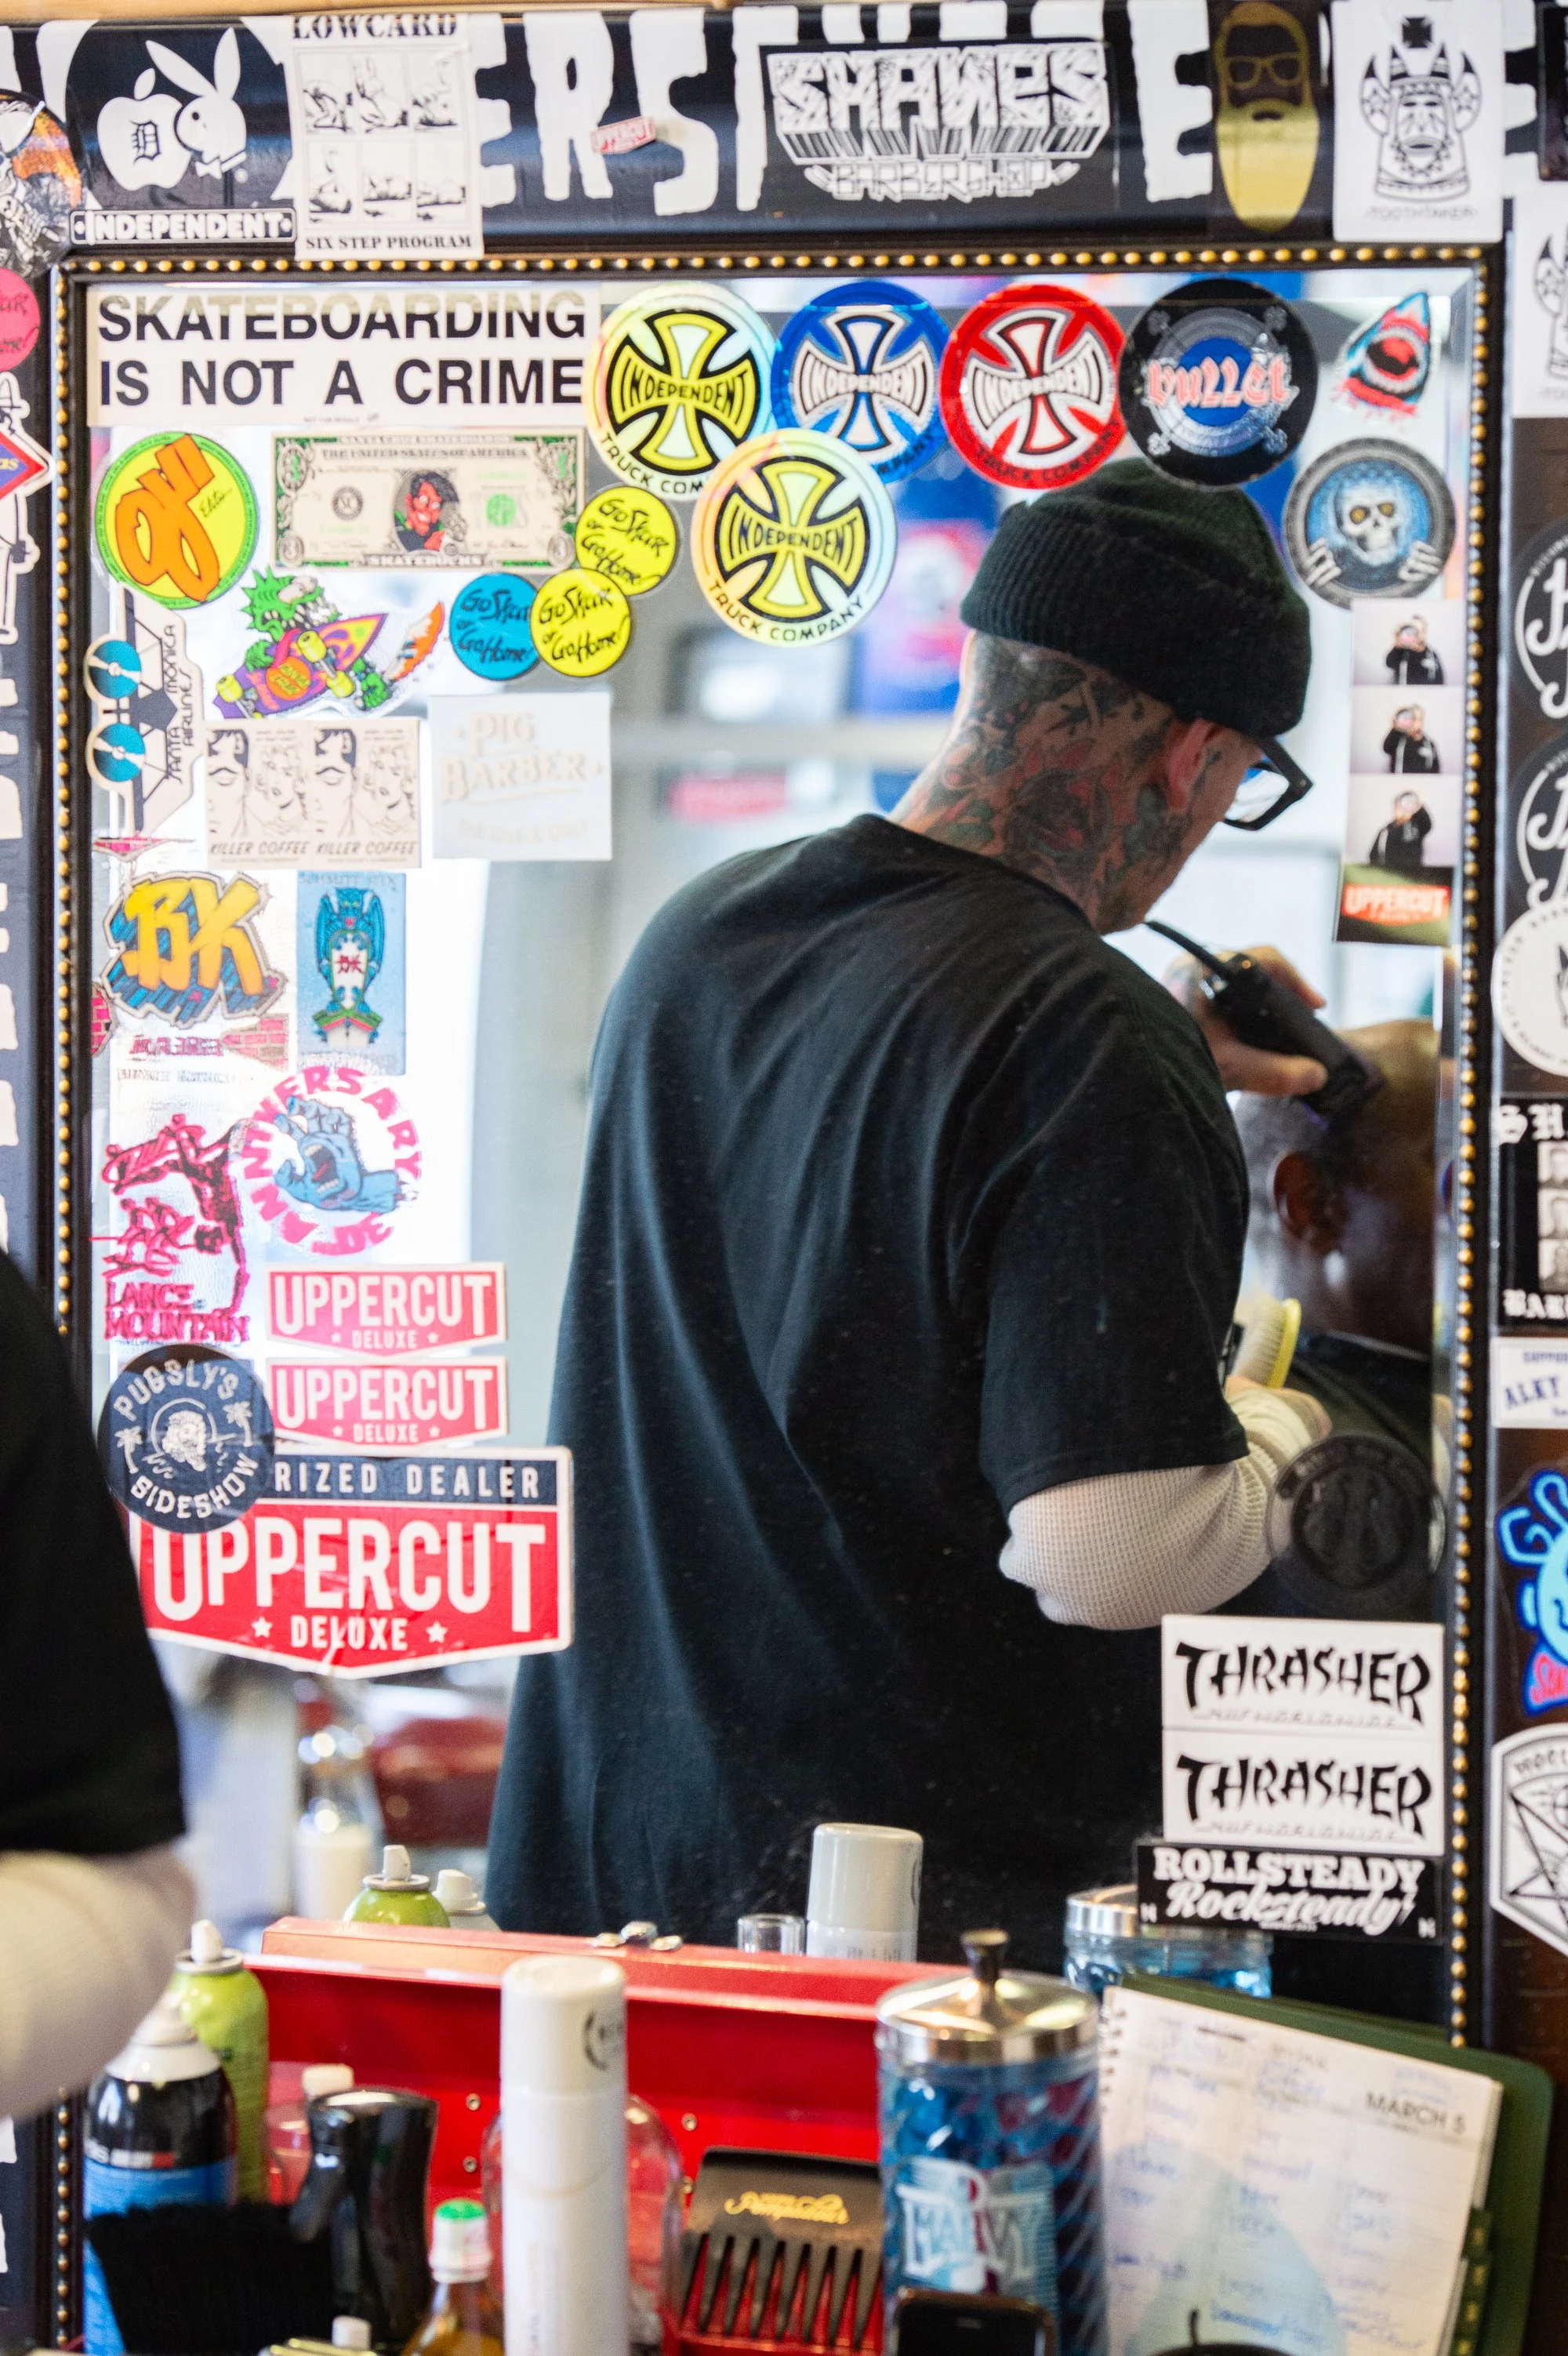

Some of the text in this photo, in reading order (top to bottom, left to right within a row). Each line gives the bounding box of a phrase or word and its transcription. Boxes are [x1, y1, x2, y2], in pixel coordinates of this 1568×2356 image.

[292, 13, 457, 39] LOWCARD
[86, 212, 282, 241] INDEPENDENT
[307, 235, 472, 251] SIX STEP PROGRAM
[99, 289, 586, 340] SKATEBOARDING
[100, 358, 583, 405] IS NOT A CRIME
[629, 361, 750, 427] INDEPENDENT
[815, 361, 928, 412] INDEPENDENT
[985, 350, 1096, 416] INDEPENDENT
[322, 448, 349, 459] THE
[470, 448, 528, 458] AMERICA
[600, 432, 652, 487] TRUCK
[735, 505, 858, 574] INDEPENDENT
[710, 579, 866, 642] TRUCK COMPANY
[163, 625, 177, 694] MONICA
[180, 669, 193, 746] AIRLINES
[470, 712, 535, 757] PIG
[441, 750, 586, 804] BARBER
[209, 840, 310, 855] KILLER COFFEE
[316, 840, 418, 855] KILLER COFFEE
[103, 1312, 251, 1343] MOUNTAIN
[274, 1274, 493, 1336] UPPERCUT
[351, 1330, 418, 1349] DELUXE
[114, 1358, 239, 1421] PUGSLY'S
[274, 1364, 494, 1430] UPPERCUT
[352, 1424, 420, 1443] DELUXE
[130, 1452, 259, 1519] SIDESHOW
[276, 1460, 539, 1498] RIZED DEALER
[151, 1518, 547, 1633] UPPERCUT
[290, 1616, 408, 1651] DELUXE
[1175, 1642, 1431, 1725] THRASHER
[1176, 1754, 1432, 1839] THRASHER
[1152, 1846, 1426, 1893] ROLLSTEADY
[1365, 2090, 1447, 2126] MARCH
